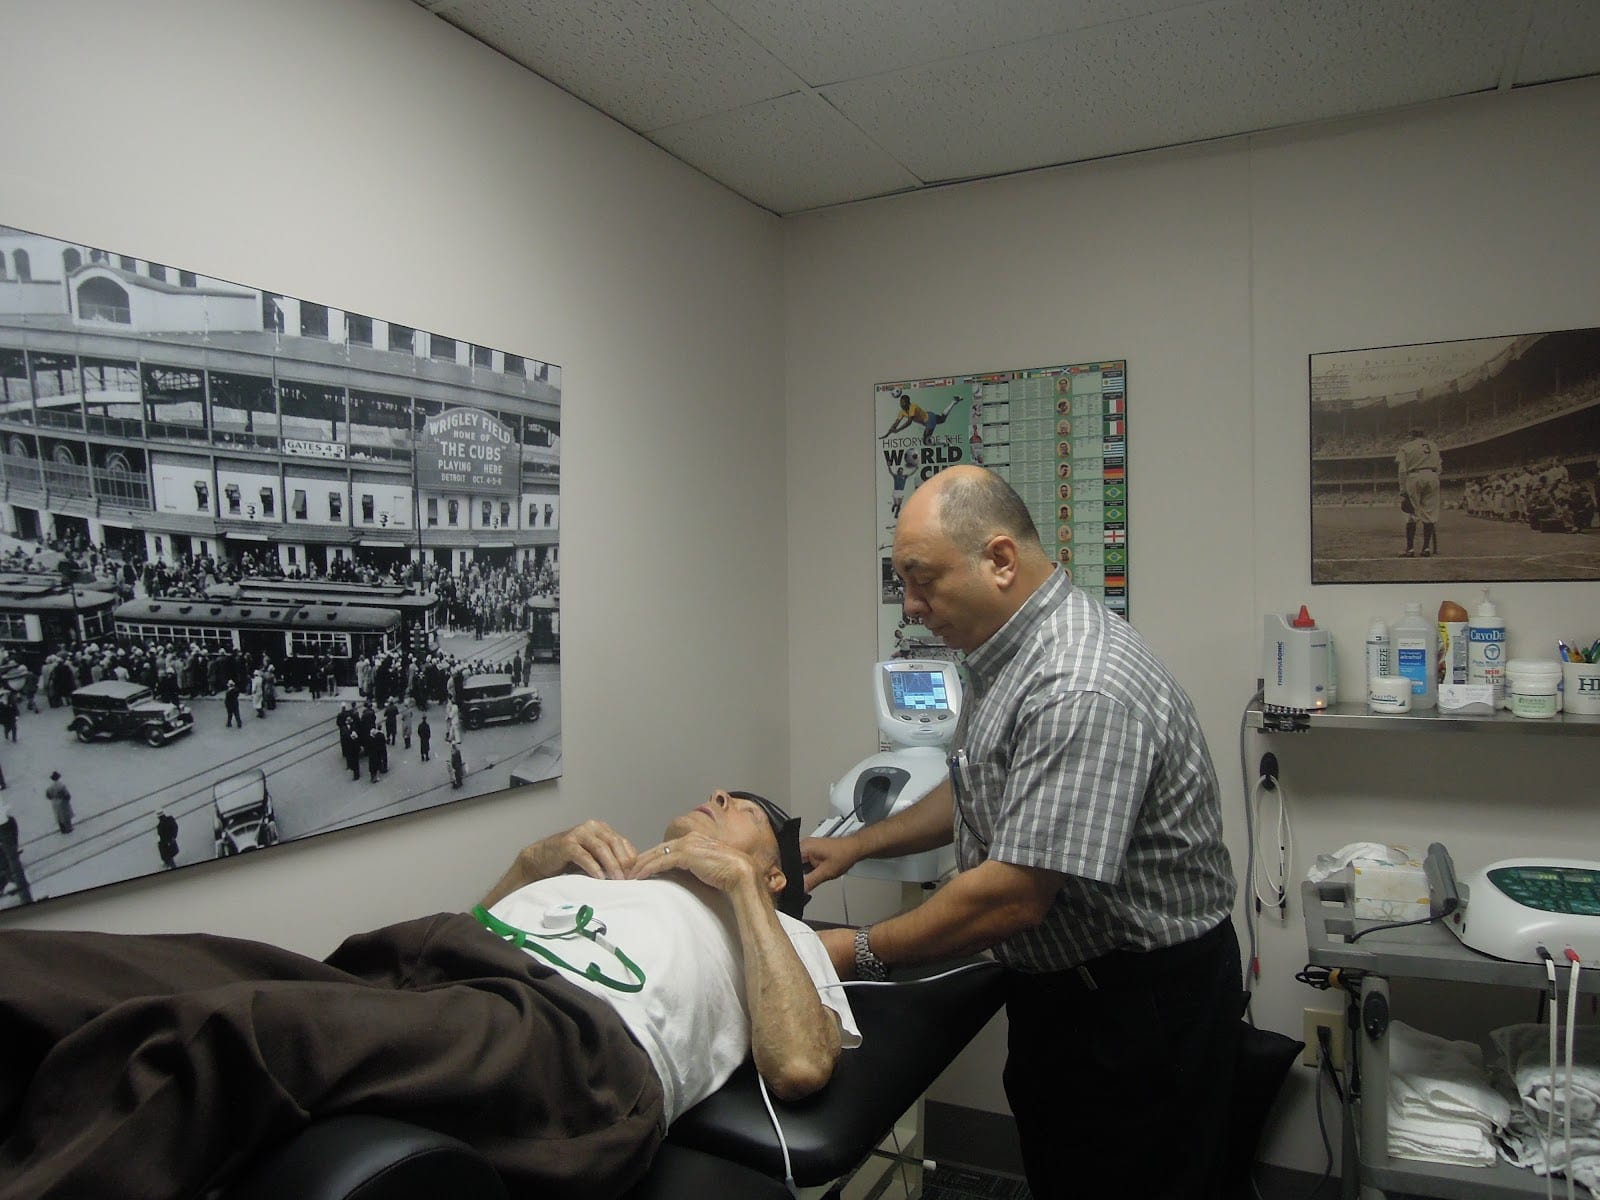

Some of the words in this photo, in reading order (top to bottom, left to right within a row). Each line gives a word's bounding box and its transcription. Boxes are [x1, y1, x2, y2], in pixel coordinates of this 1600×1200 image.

[429, 412, 478, 435] WRIGLEY
[482, 416, 511, 444] FIELD
[453, 430, 475, 440] HOME
[480, 434, 490, 442] OF
[287, 441, 321, 450] GATES
[883, 438, 923, 448] HISTORY
[1422, 443, 1431, 454] 3
[438, 460, 471, 472] PLAYING
[483, 464, 503, 474] HERE
[441, 473, 466, 482] DETROIT
[247, 505, 256, 515] 3
[379, 514, 388, 523] 3
[1379, 648, 1388, 676] FREEZE
